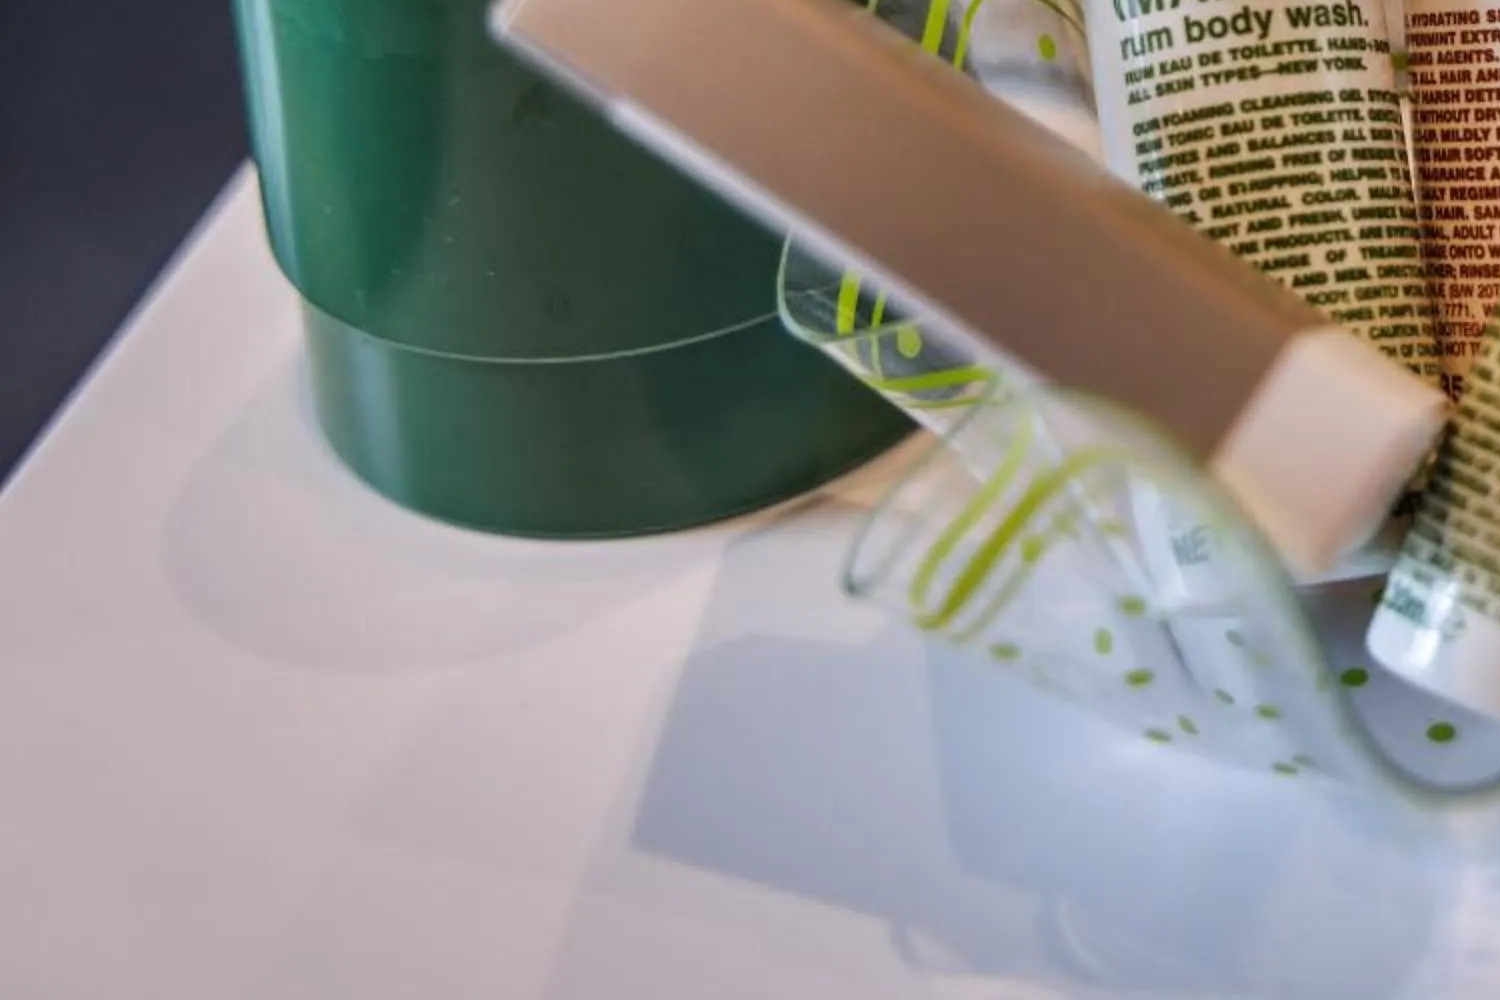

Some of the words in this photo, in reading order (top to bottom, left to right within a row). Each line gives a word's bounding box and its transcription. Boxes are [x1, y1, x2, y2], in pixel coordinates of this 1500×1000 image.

[1120, 26, 1173, 60] rum
[1184, 4, 1273, 44] body
[1159, 56, 1192, 75] EAU
[1198, 50, 1222, 67] DE
[1437, 48, 1500, 65] AGENTS.
[1440, 69, 1472, 84] HAIR
[1155, 76, 1194, 97] SKIN
[1162, 102, 1234, 127] FOAMING
[1240, 90, 1334, 113] CLEANSING
[1168, 126, 1214, 147] TONIC
[1221, 119, 1254, 136] EAU
[1261, 115, 1283, 131] DE
[1441, 127, 1490, 142] MILDLY
[1206, 142, 1241, 161] AND
[1247, 129, 1336, 152] BALANCES
[1435, 204, 1469, 220] HAIR.
[1453, 224, 1495, 239] ADULT
[1326, 249, 1346, 263] OF
[1450, 244, 1486, 260] ONTO
